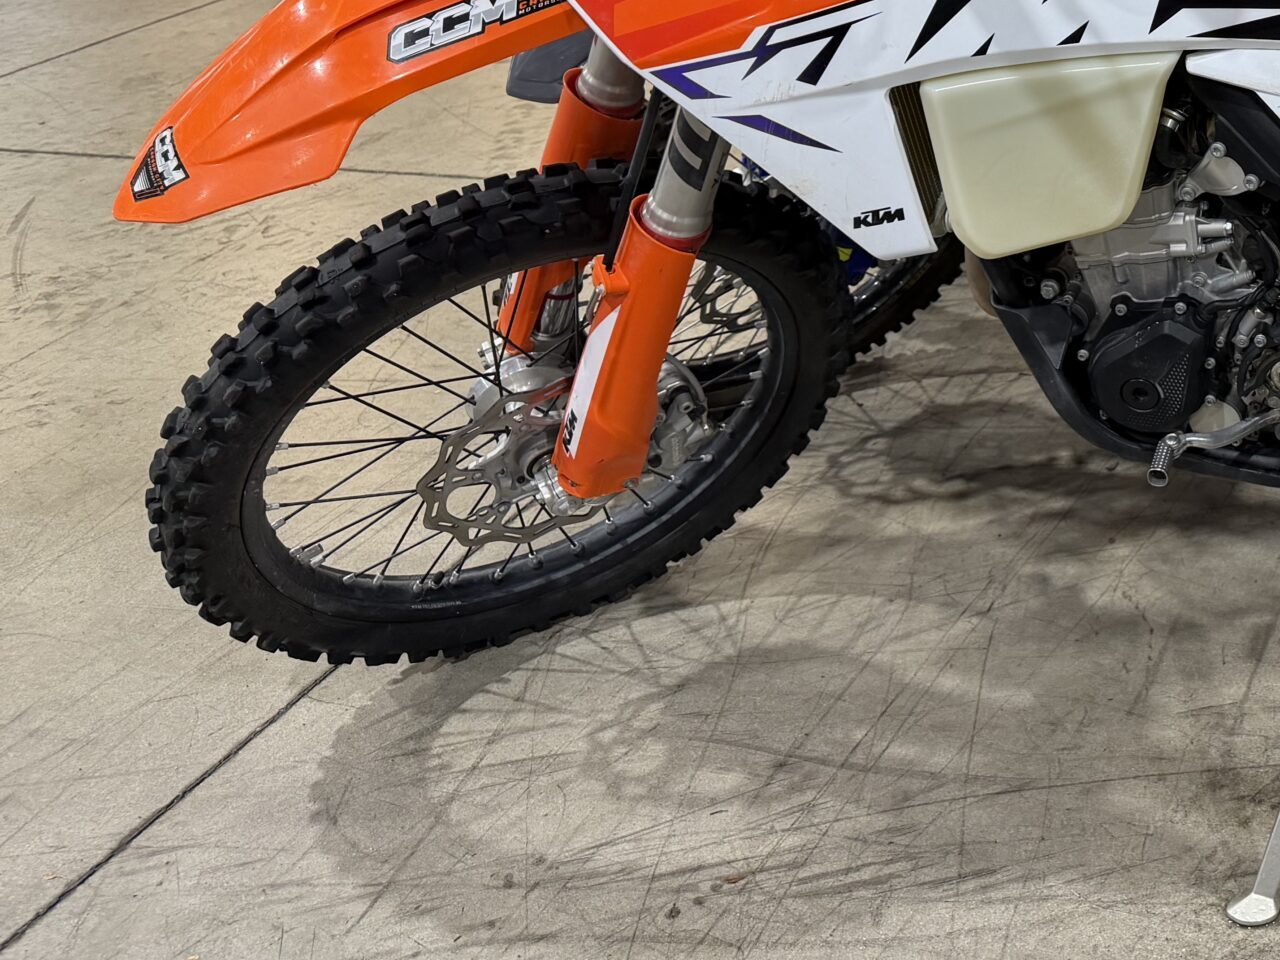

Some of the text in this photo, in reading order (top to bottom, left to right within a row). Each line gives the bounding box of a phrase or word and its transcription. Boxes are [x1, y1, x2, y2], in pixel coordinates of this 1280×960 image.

[155, 128, 187, 187] CCM
[853, 206, 905, 229] KTM
[563, 408, 578, 454] KTM
